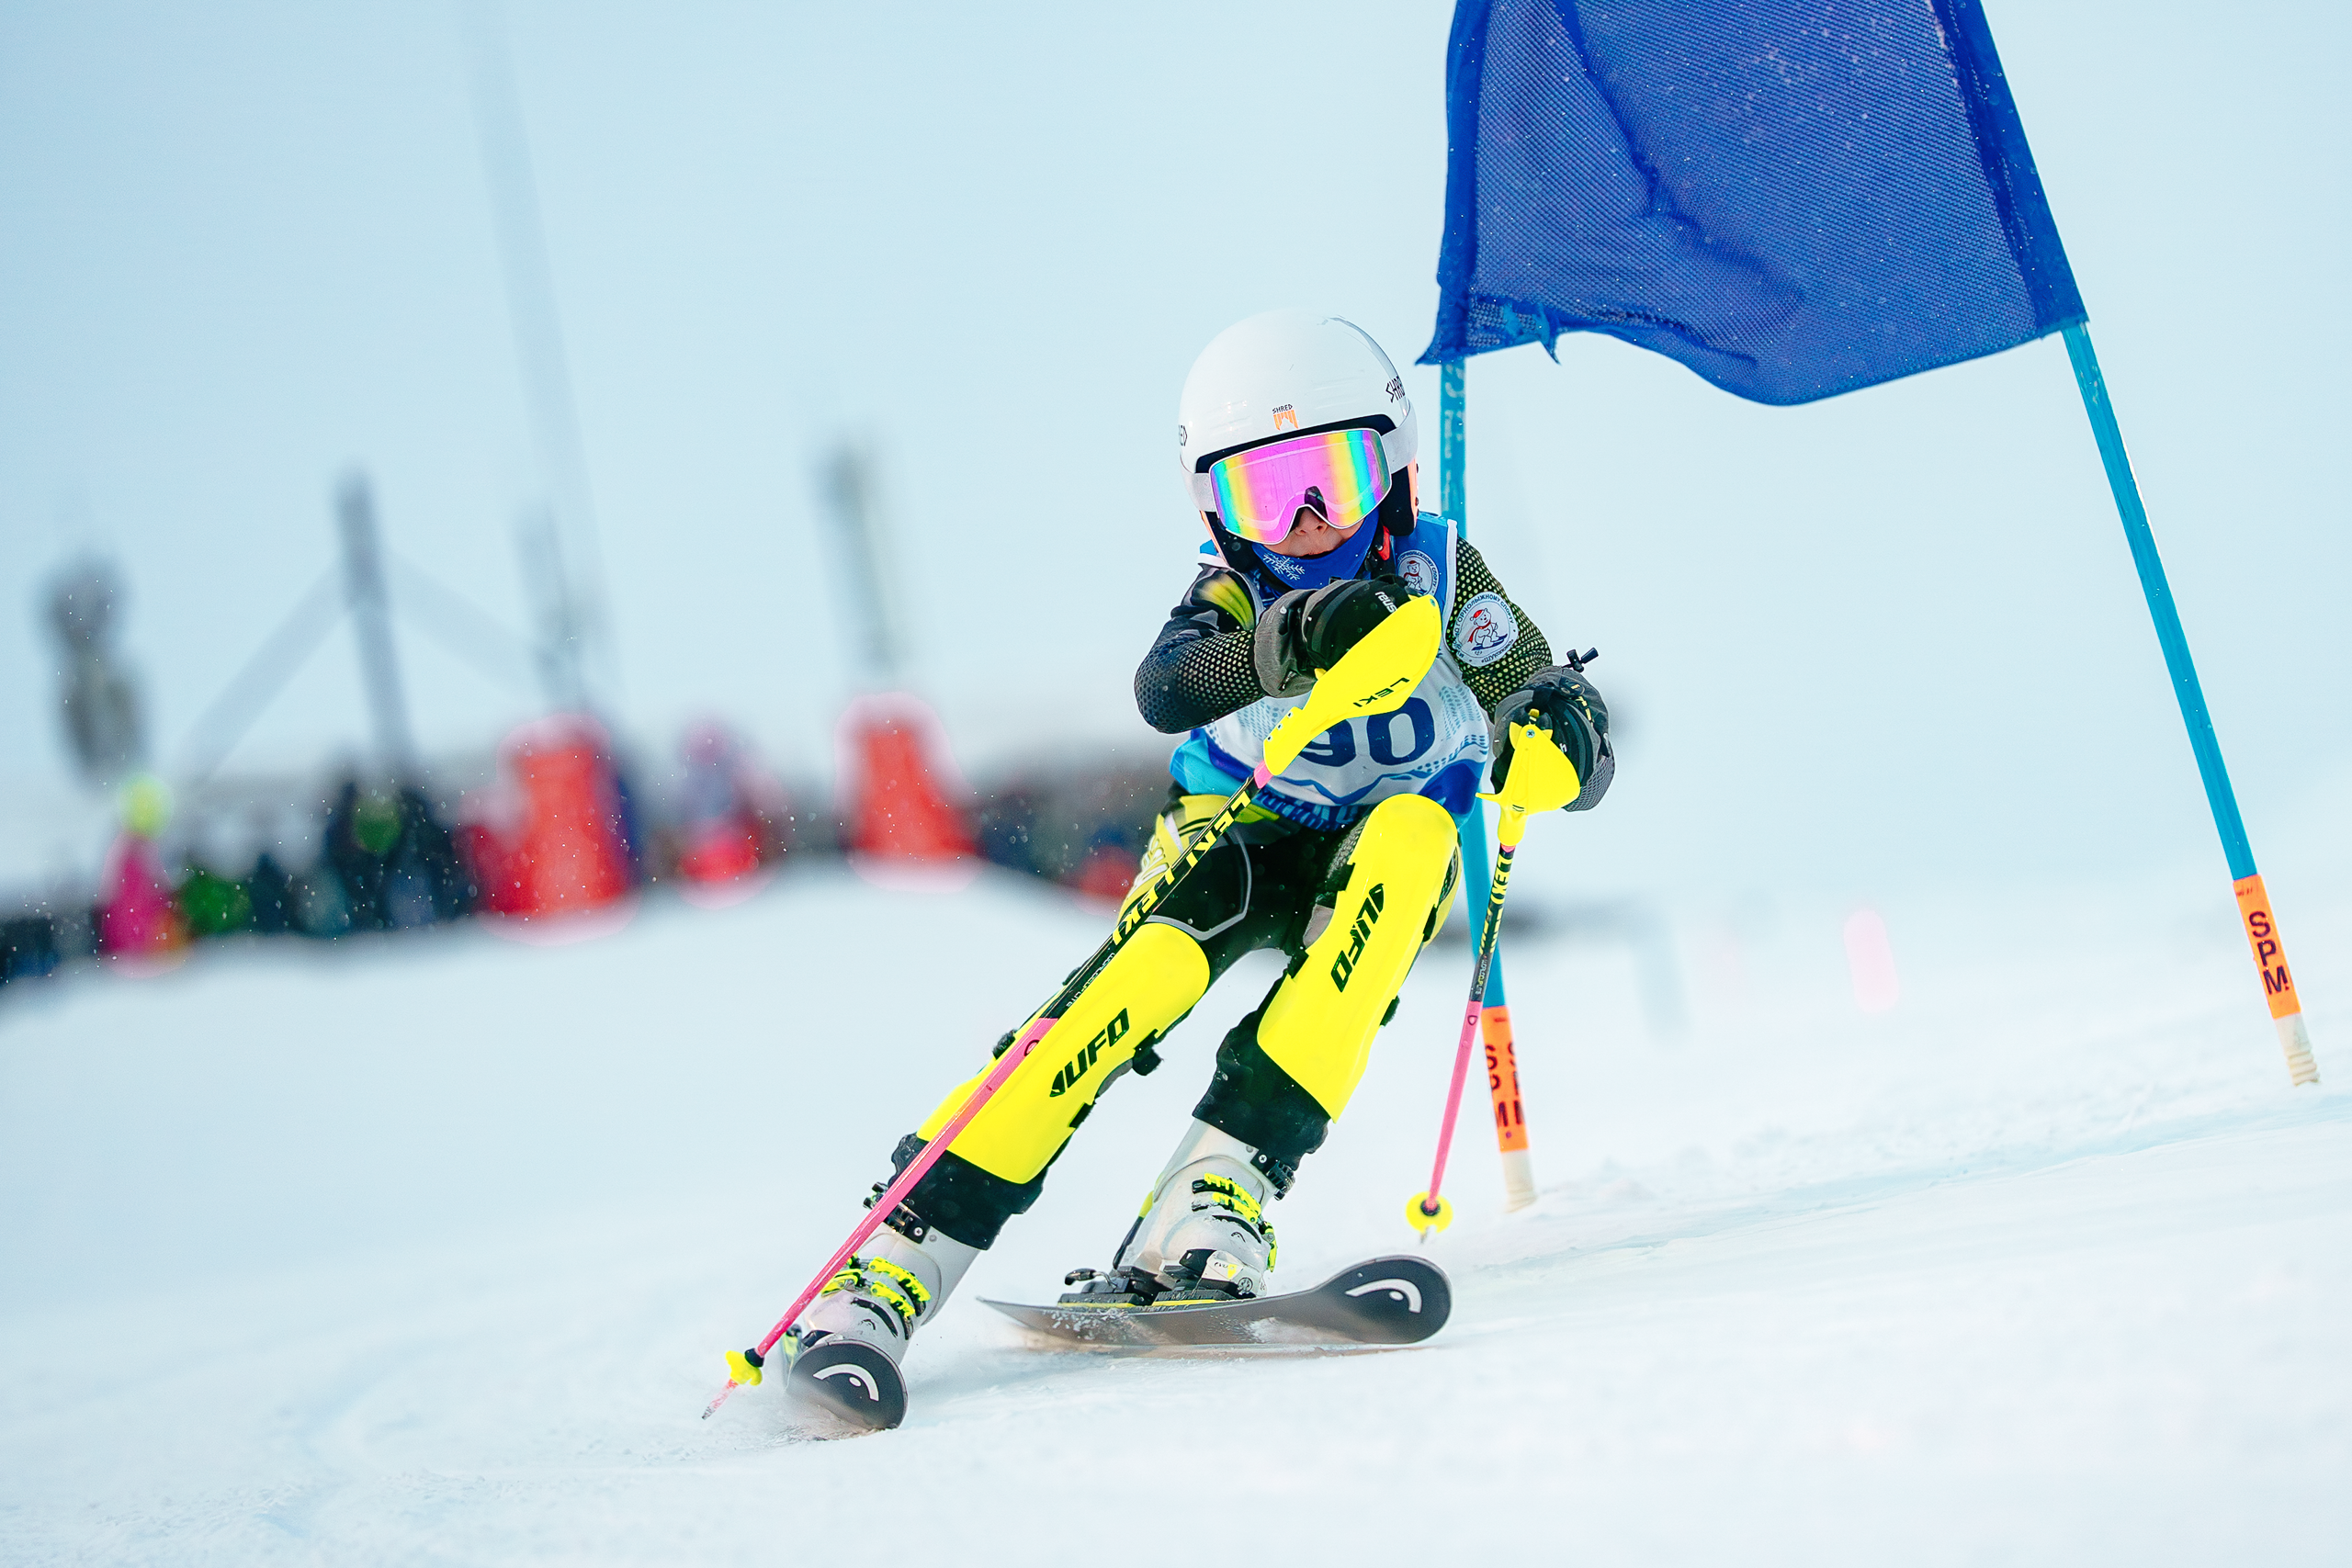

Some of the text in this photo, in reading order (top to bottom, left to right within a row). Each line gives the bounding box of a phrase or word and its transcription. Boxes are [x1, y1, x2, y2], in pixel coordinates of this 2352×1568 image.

[1272, 403, 1294, 414] SHRED
[1374, 591, 1397, 614] reus
[1456, 594, 1501, 626] ГОРНОЛЫЖНОМУ
[1500, 601, 1514, 624] СПОРТУ
[1352, 677, 1410, 707] LEKI
[1297, 696, 1436, 767] 90
[1185, 790, 1251, 868] LEKI
[1490, 853, 1513, 905] LEKI
[1330, 897, 1379, 993] UFO
[1065, 1008, 1130, 1089] UFO
